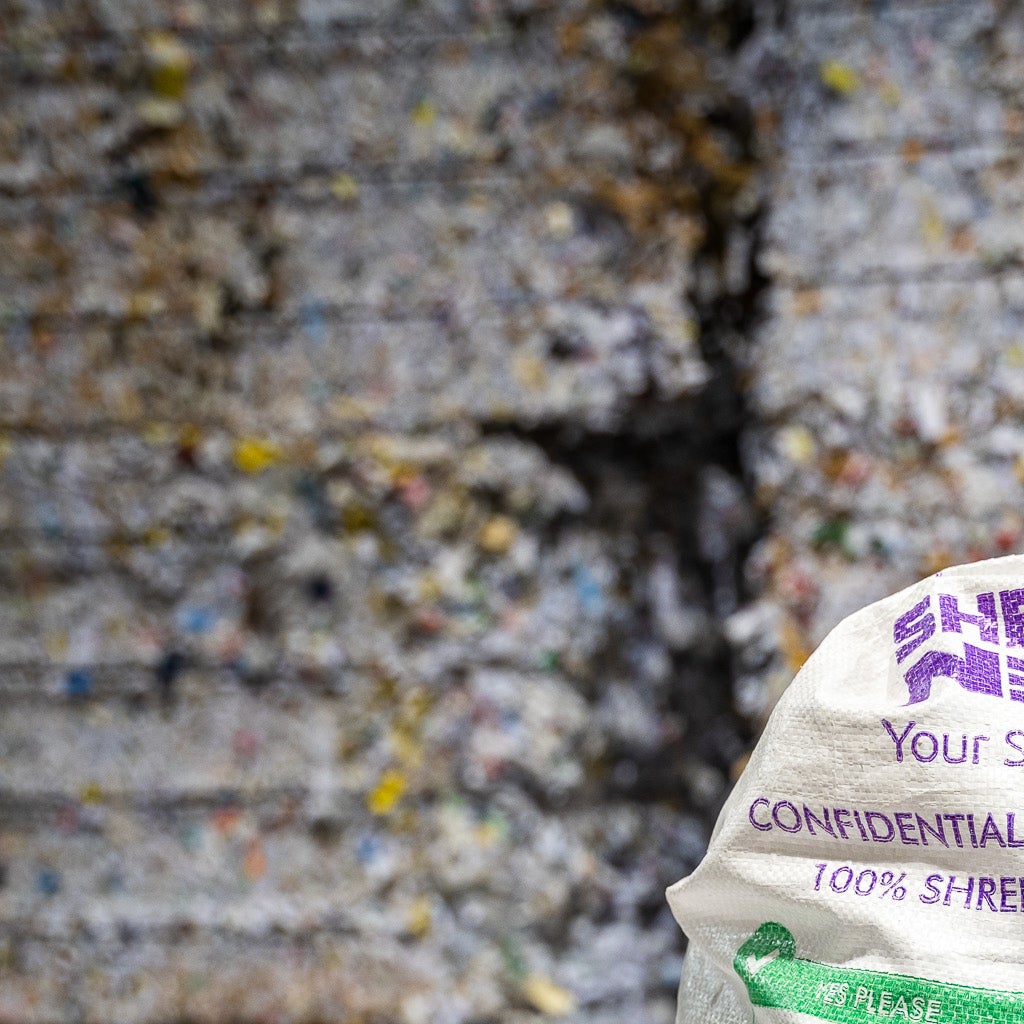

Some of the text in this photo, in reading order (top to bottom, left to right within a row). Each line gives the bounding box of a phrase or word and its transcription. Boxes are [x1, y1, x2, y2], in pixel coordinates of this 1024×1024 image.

[881, 719, 990, 764] Your
[814, 863, 907, 900] 100%
[815, 980, 942, 1024] YES PLEASE
